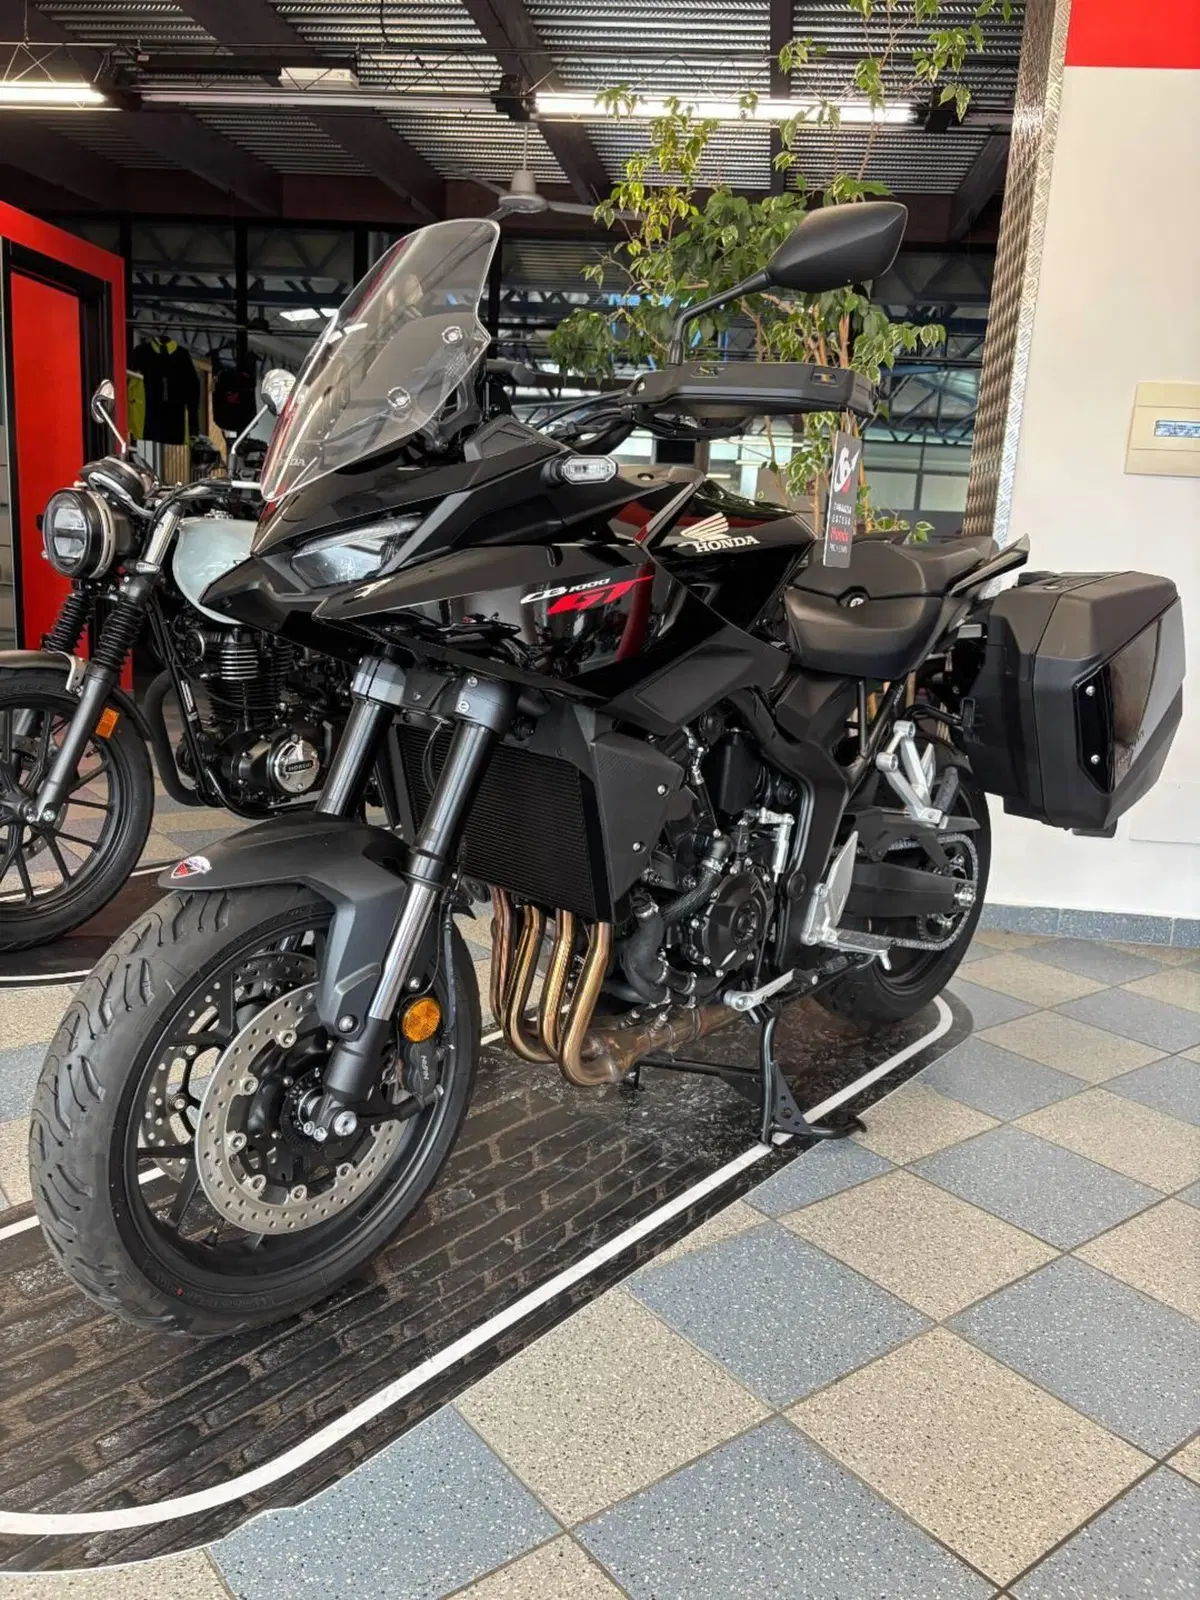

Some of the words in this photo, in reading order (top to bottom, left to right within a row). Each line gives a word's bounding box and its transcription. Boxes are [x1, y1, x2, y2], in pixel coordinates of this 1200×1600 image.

[695, 535, 760, 553] HONDA
[520, 586, 567, 604] CB
[568, 577, 610, 592] 1000
